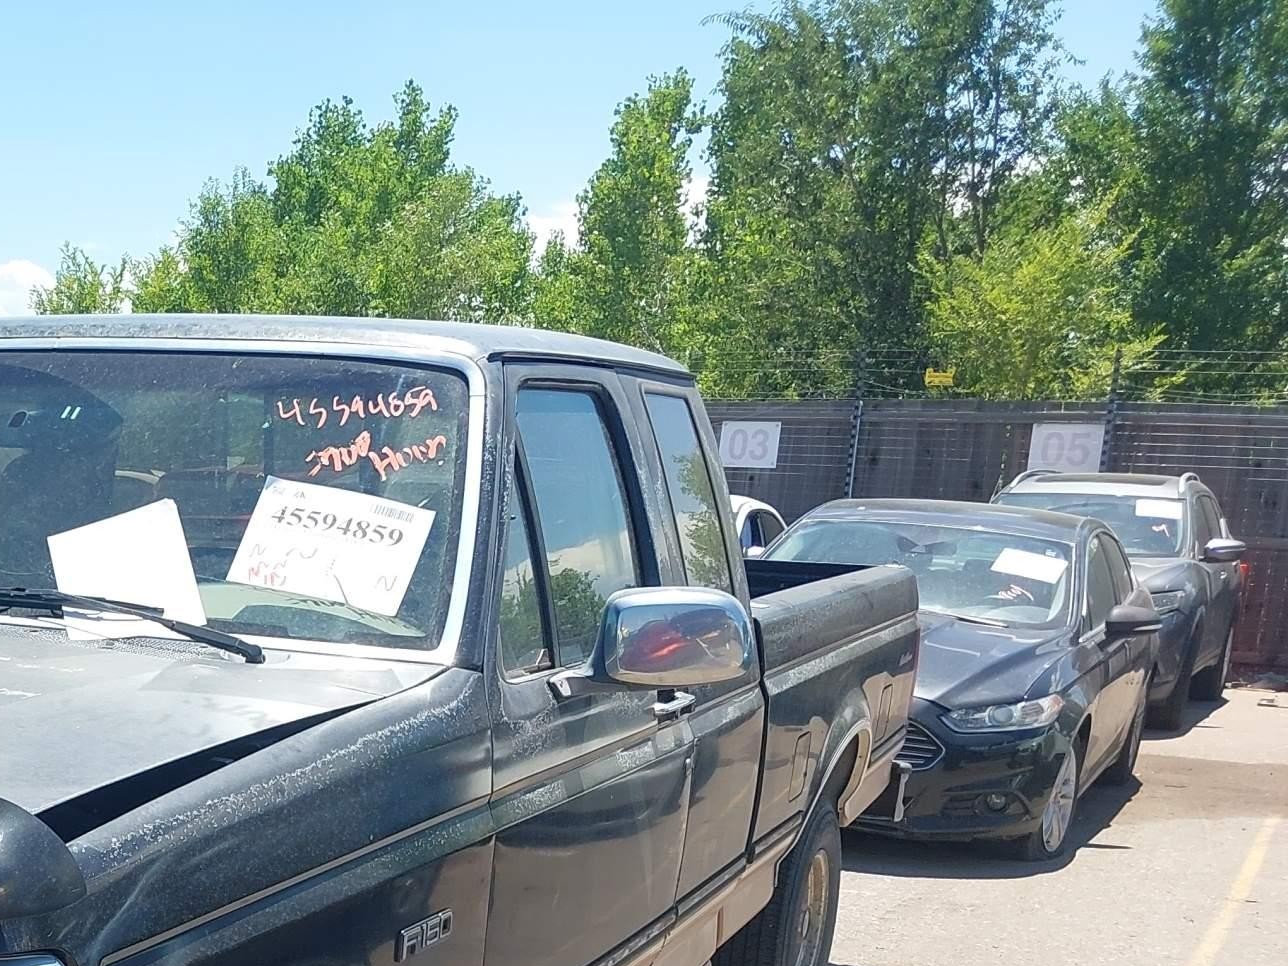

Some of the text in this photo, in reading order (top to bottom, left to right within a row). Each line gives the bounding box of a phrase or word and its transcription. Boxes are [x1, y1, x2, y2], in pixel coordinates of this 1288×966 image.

[277, 386, 438, 429] 45594859
[728, 428, 770, 461] 03
[1040, 431, 1092, 467] 05
[271, 506, 404, 546] 45594859
